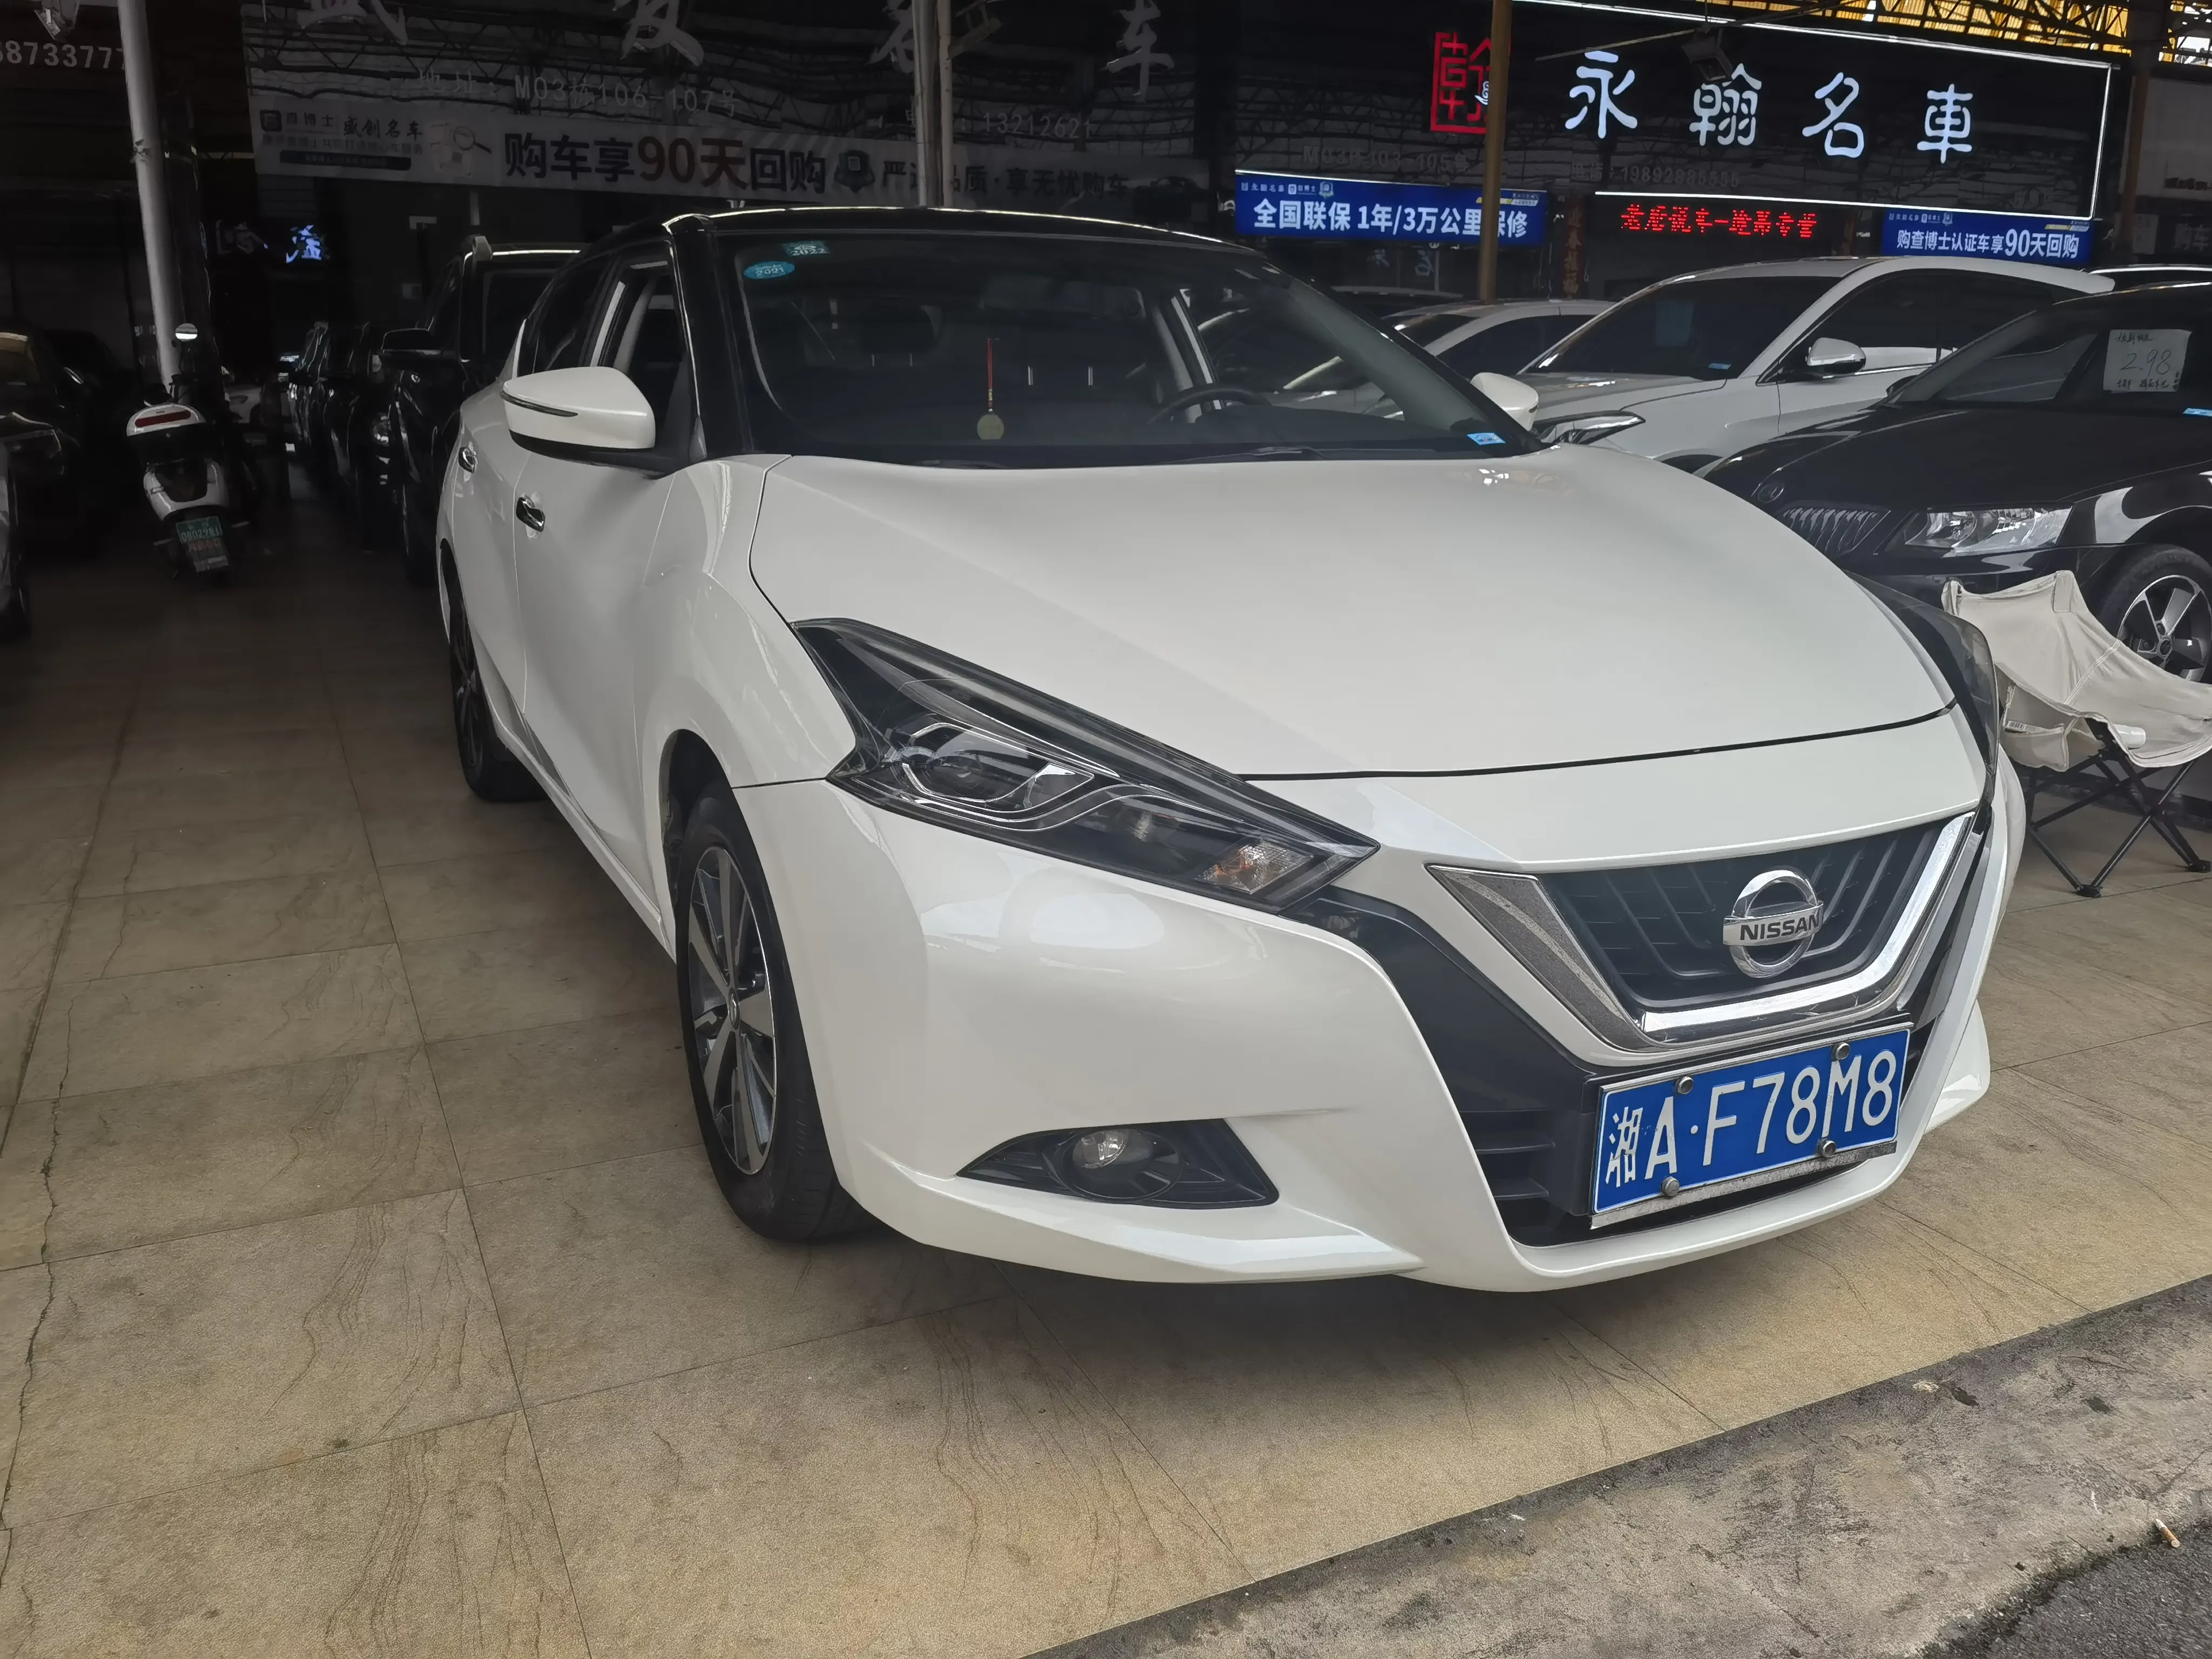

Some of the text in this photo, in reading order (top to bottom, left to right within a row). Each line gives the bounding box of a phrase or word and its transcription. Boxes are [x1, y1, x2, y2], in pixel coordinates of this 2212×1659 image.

[0, 40, 126, 70] 873377
[1564, 51, 1973, 163] 永翰名車
[504, 132, 826, 194] 购车享90天回购
[1253, 198, 1351, 232] 全国联保
[1897, 228, 2080, 259] 购查博士认证车享90天回购
[2120, 349, 2171, 376] 2.98
[1740, 914, 1819, 940] NISSAN
